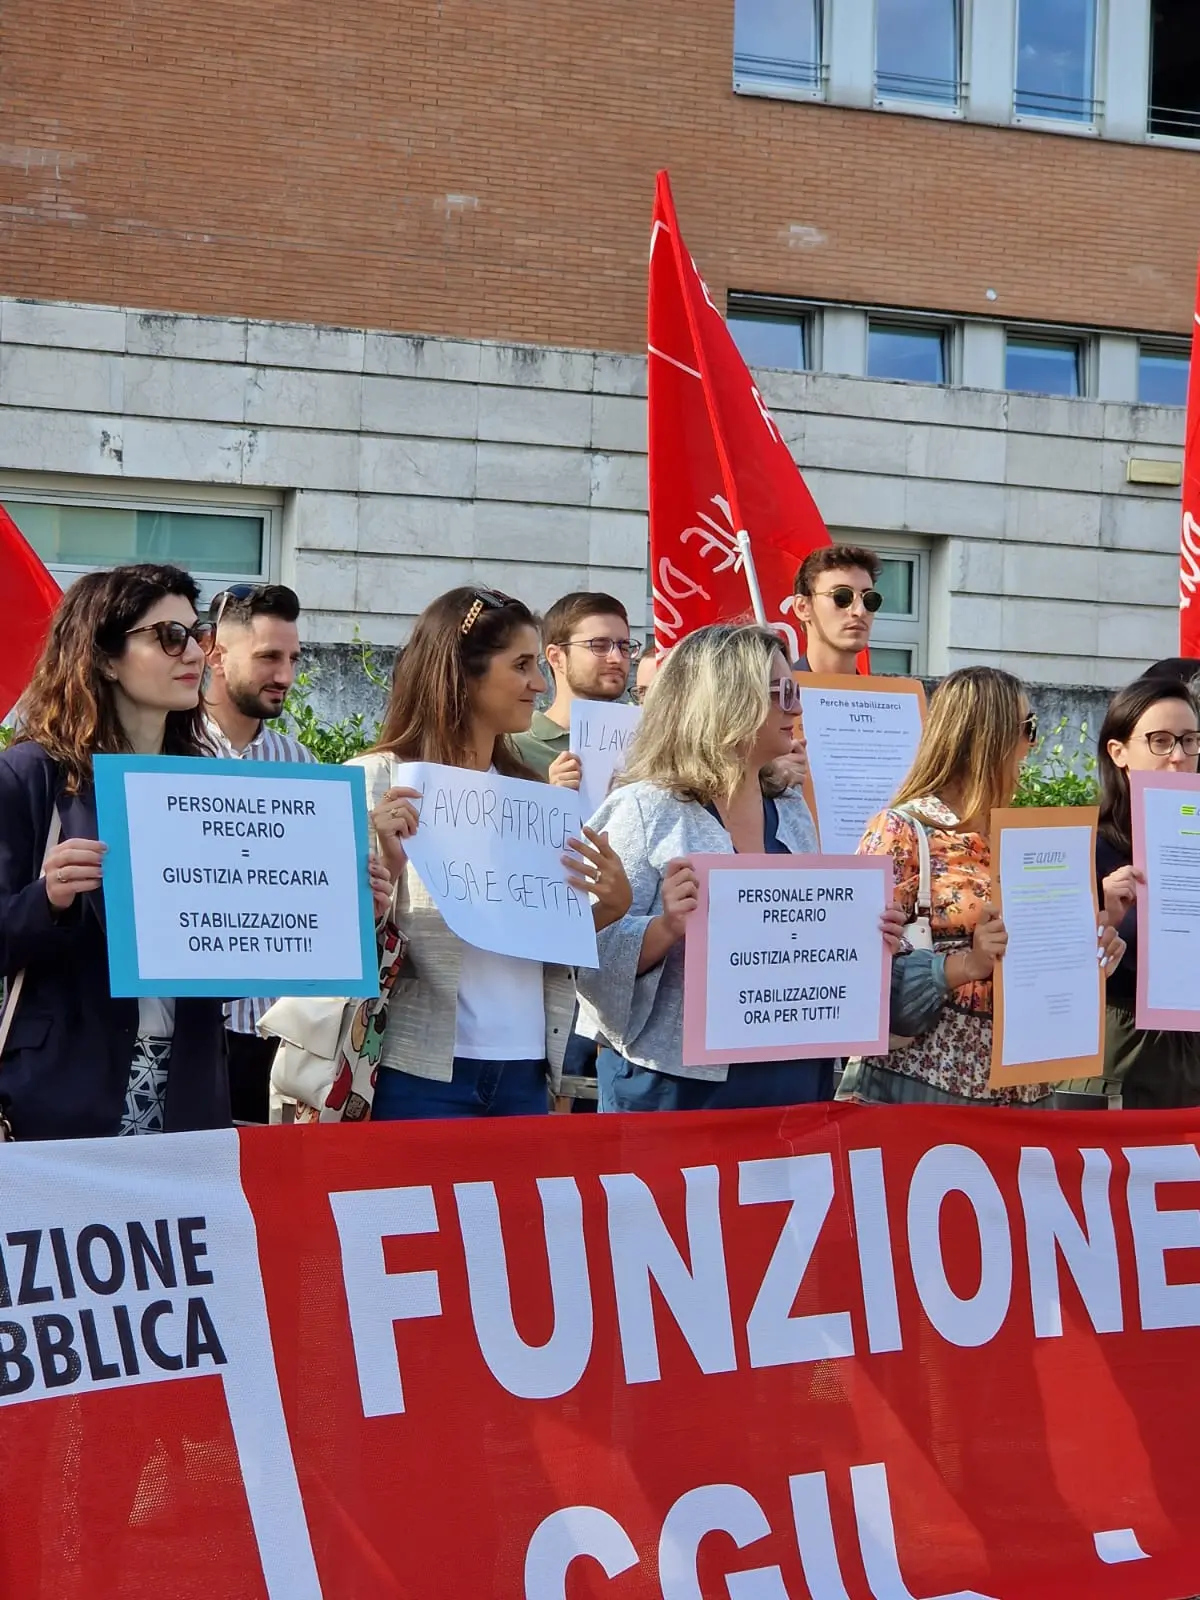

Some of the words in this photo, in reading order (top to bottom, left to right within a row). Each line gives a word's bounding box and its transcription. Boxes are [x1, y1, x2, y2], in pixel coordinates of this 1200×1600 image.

[851, 701, 902, 711] stabilizzarci
[578, 719, 592, 750] IL
[167, 795, 267, 815] PERSONALE
[271, 799, 316, 816] PNRR
[417, 782, 574, 853] LAVORATRICE
[202, 820, 286, 839] PRECARIO
[241, 849, 250, 858] =
[162, 867, 243, 884] GIUSTIZIA
[247, 869, 329, 886] PRECARIA
[425, 860, 480, 905] USA
[486, 870, 502, 902] E
[507, 873, 582, 918] GETTA
[738, 888, 813, 904] PERSONALE
[817, 887, 854, 902] PNRR
[179, 911, 319, 929] STABILIZZAZIONE
[762, 908, 827, 924] PRECARIO
[188, 935, 225, 953] ORA
[228, 936, 260, 953] PER
[263, 936, 313, 954] TUTTI!
[791, 932, 798, 940] =
[729, 949, 791, 967] GIUSTIZIA
[793, 948, 858, 964] PRECARIA
[738, 985, 847, 1005] STABILIZZAZIONE
[743, 1009, 771, 1025] ORA
[774, 1007, 798, 1023] PER
[801, 1005, 840, 1022] TUTTI!
[0, 1216, 215, 1309] ZIONE
[329, 1143, 1200, 1418] FUNZIONE
[525, 1463, 1000, 1600] CGIL
